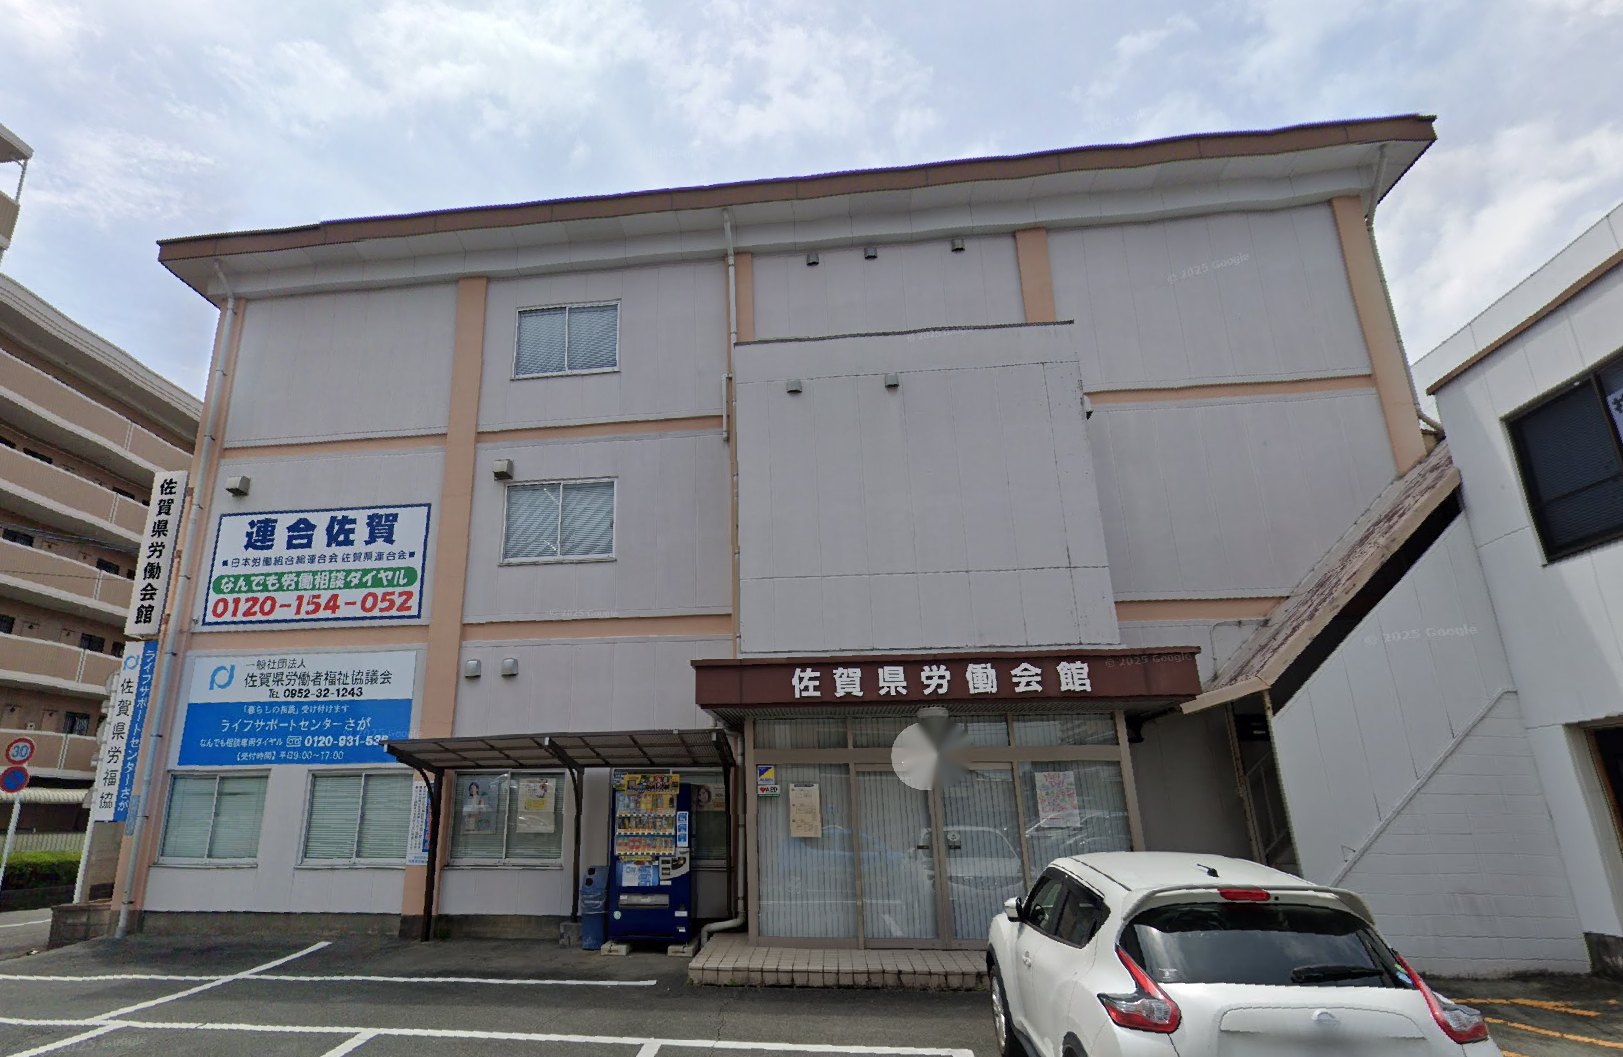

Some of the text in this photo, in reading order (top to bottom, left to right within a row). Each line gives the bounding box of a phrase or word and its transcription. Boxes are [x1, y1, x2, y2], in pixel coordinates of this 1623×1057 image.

[243, 512, 399, 552] 連合佐賀
[135, 478, 178, 625] 佐賀県労働会館
[219, 568, 408, 592] なんでも労働相談ダイヤル
[211, 590, 415, 619] 0120-154-052
[245, 658, 306, 671] 一般社団法人
[244, 669, 393, 688] 佐賀県労働者福祉協議会
[791, 660, 1092, 699] 佐賀県労働会館
[283, 686, 364, 699] 0952-32-1243
[117, 650, 156, 811] ライフサポートセンターさが
[220, 716, 372, 732] ライフサポートセンターさが
[11, 744, 29, 758] 30
[98, 678, 134, 809] 佐賀県労福協
